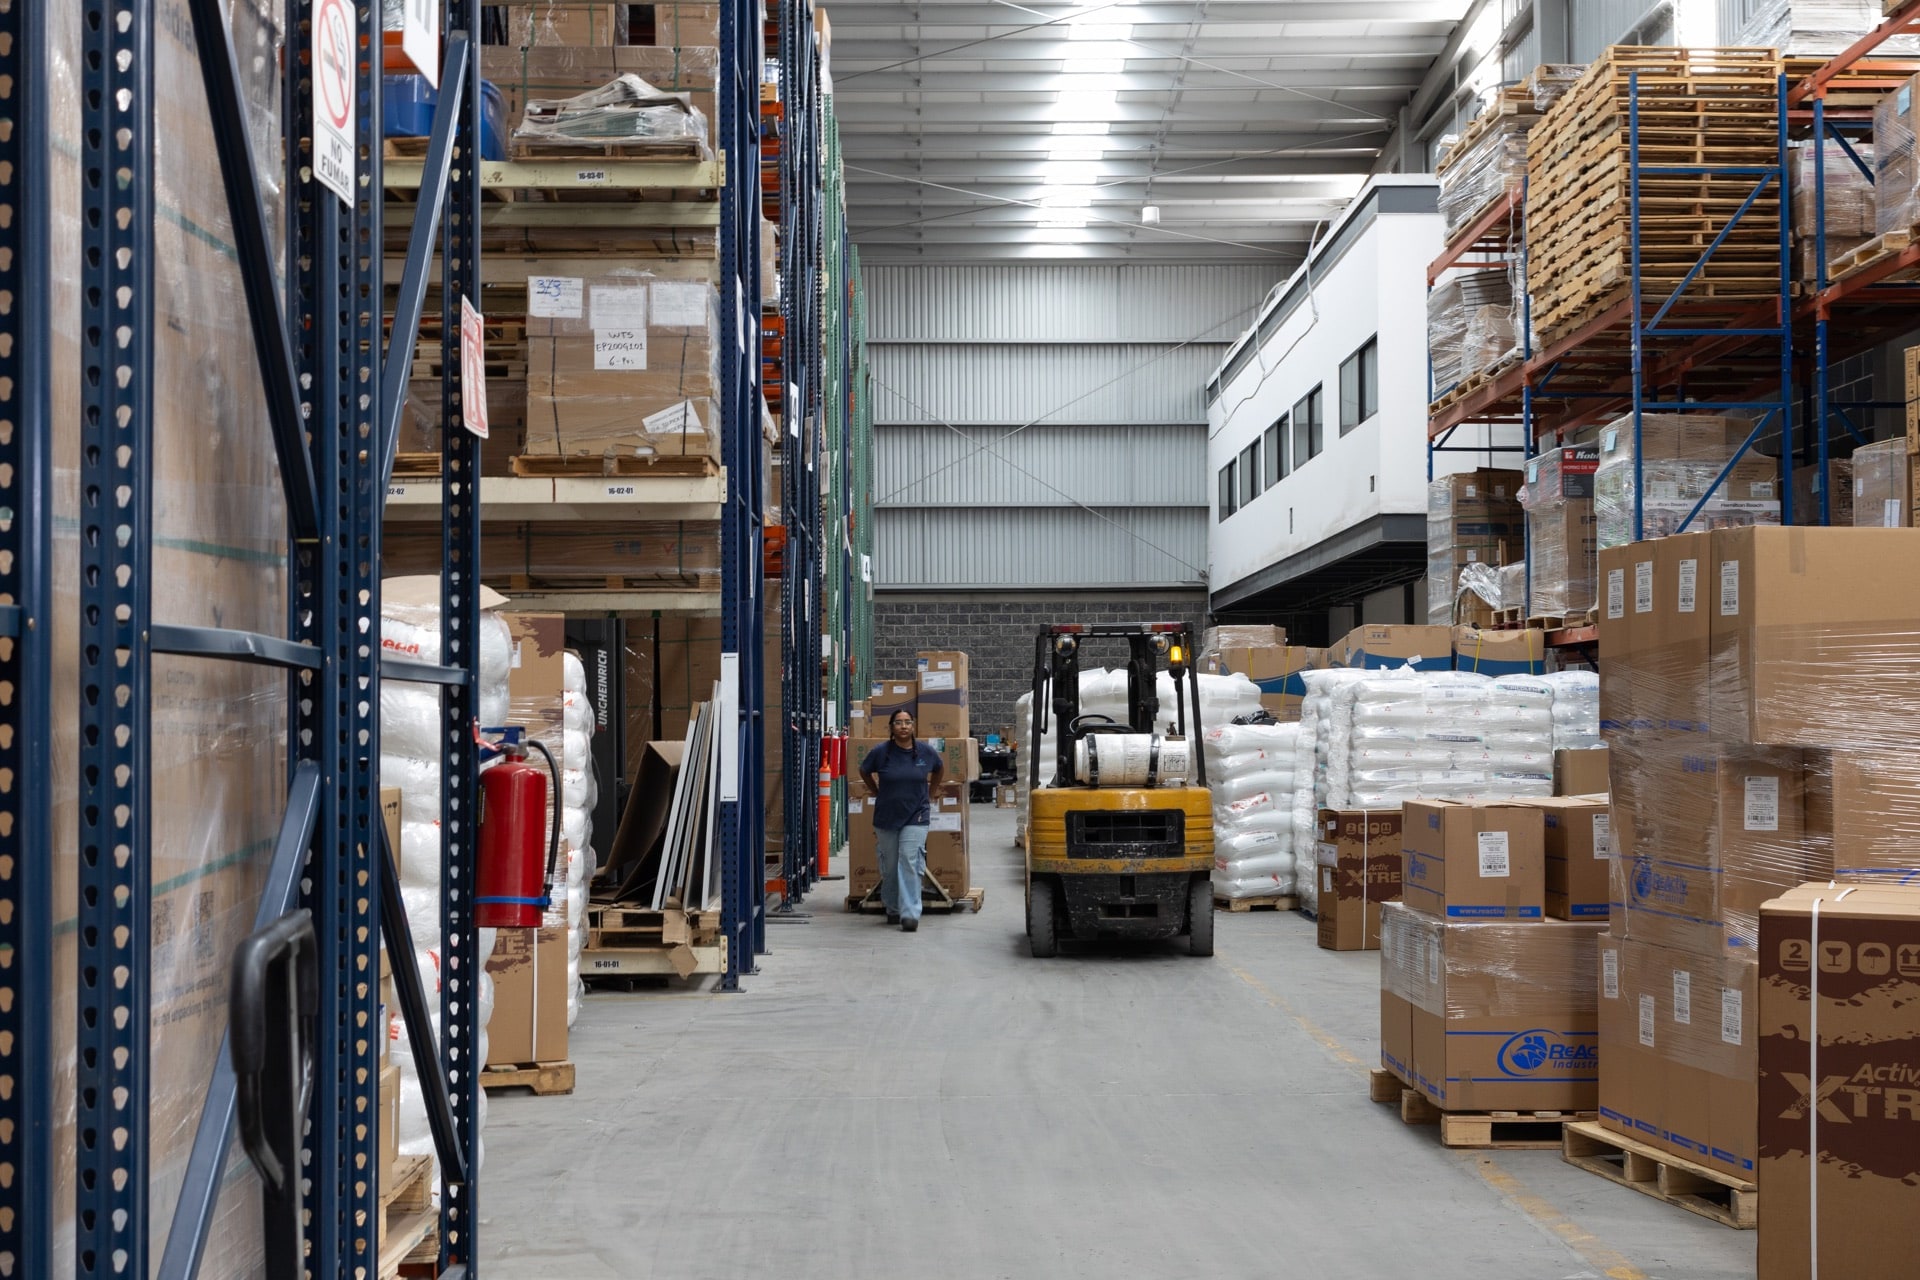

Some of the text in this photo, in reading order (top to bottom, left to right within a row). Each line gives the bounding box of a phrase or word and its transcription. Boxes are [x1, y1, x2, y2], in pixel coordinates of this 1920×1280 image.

[330, 136, 342, 165] NO
[321, 153, 350, 194] FUMAR
[578, 171, 604, 180] 16-03-01
[608, 331, 634, 339] WTS
[596, 649, 608, 732] JUNGHEINRICH
[1344, 869, 1401, 887] XTRE
[1789, 942, 1802, 958] 2
[594, 960, 620, 968] 16-01-01
[1552, 1060, 1599, 1069] Industr
[1851, 1062, 1920, 1083] Activ
[1777, 1071, 1920, 1124] XTR
